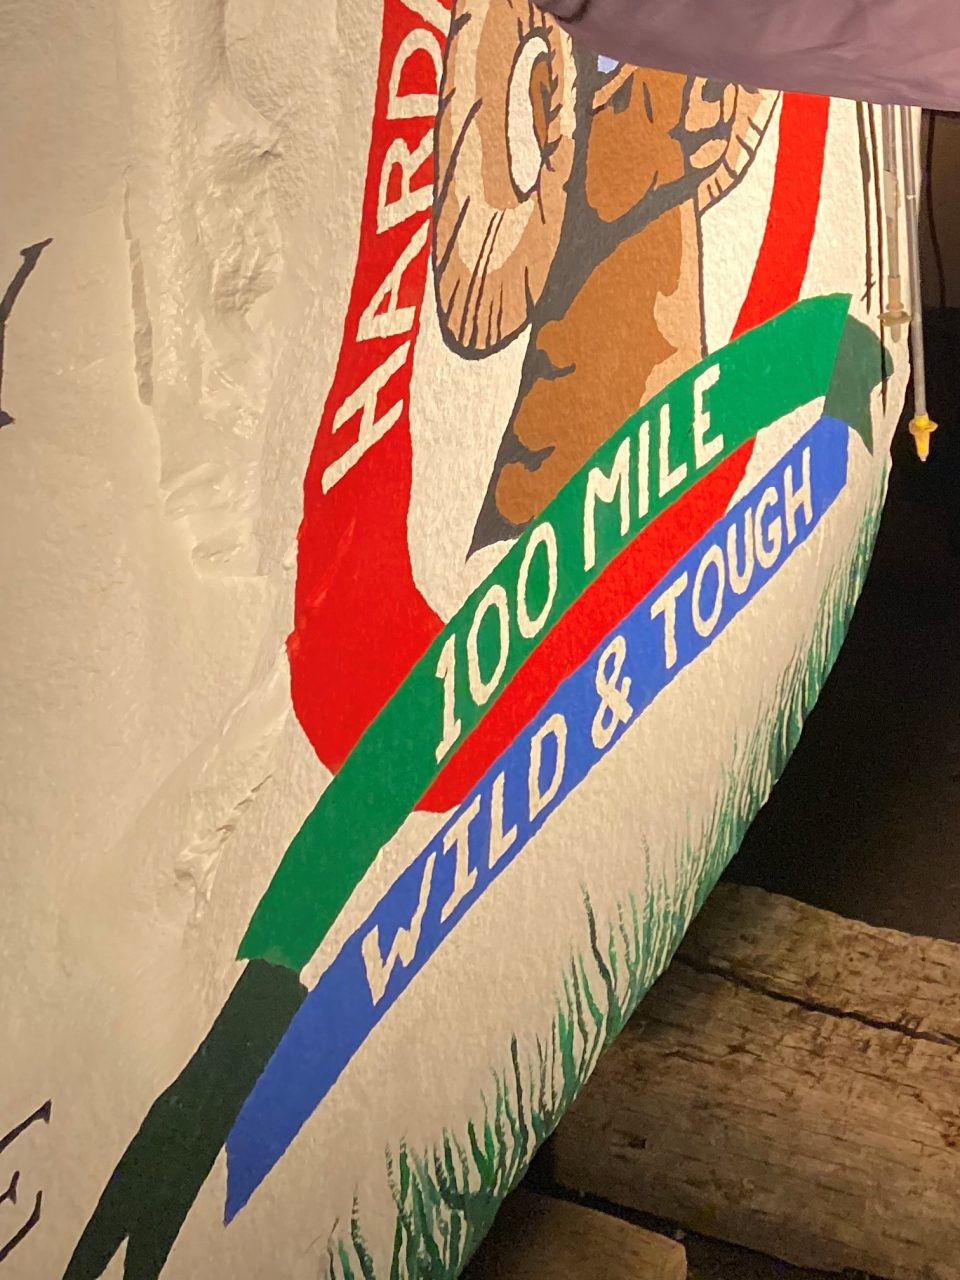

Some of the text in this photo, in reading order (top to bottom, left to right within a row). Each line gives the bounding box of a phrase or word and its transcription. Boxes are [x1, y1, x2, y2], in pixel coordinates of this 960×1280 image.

[360, 446, 813, 1007] WILD & TOUGH
[434, 363, 725, 764] 100 MILE
